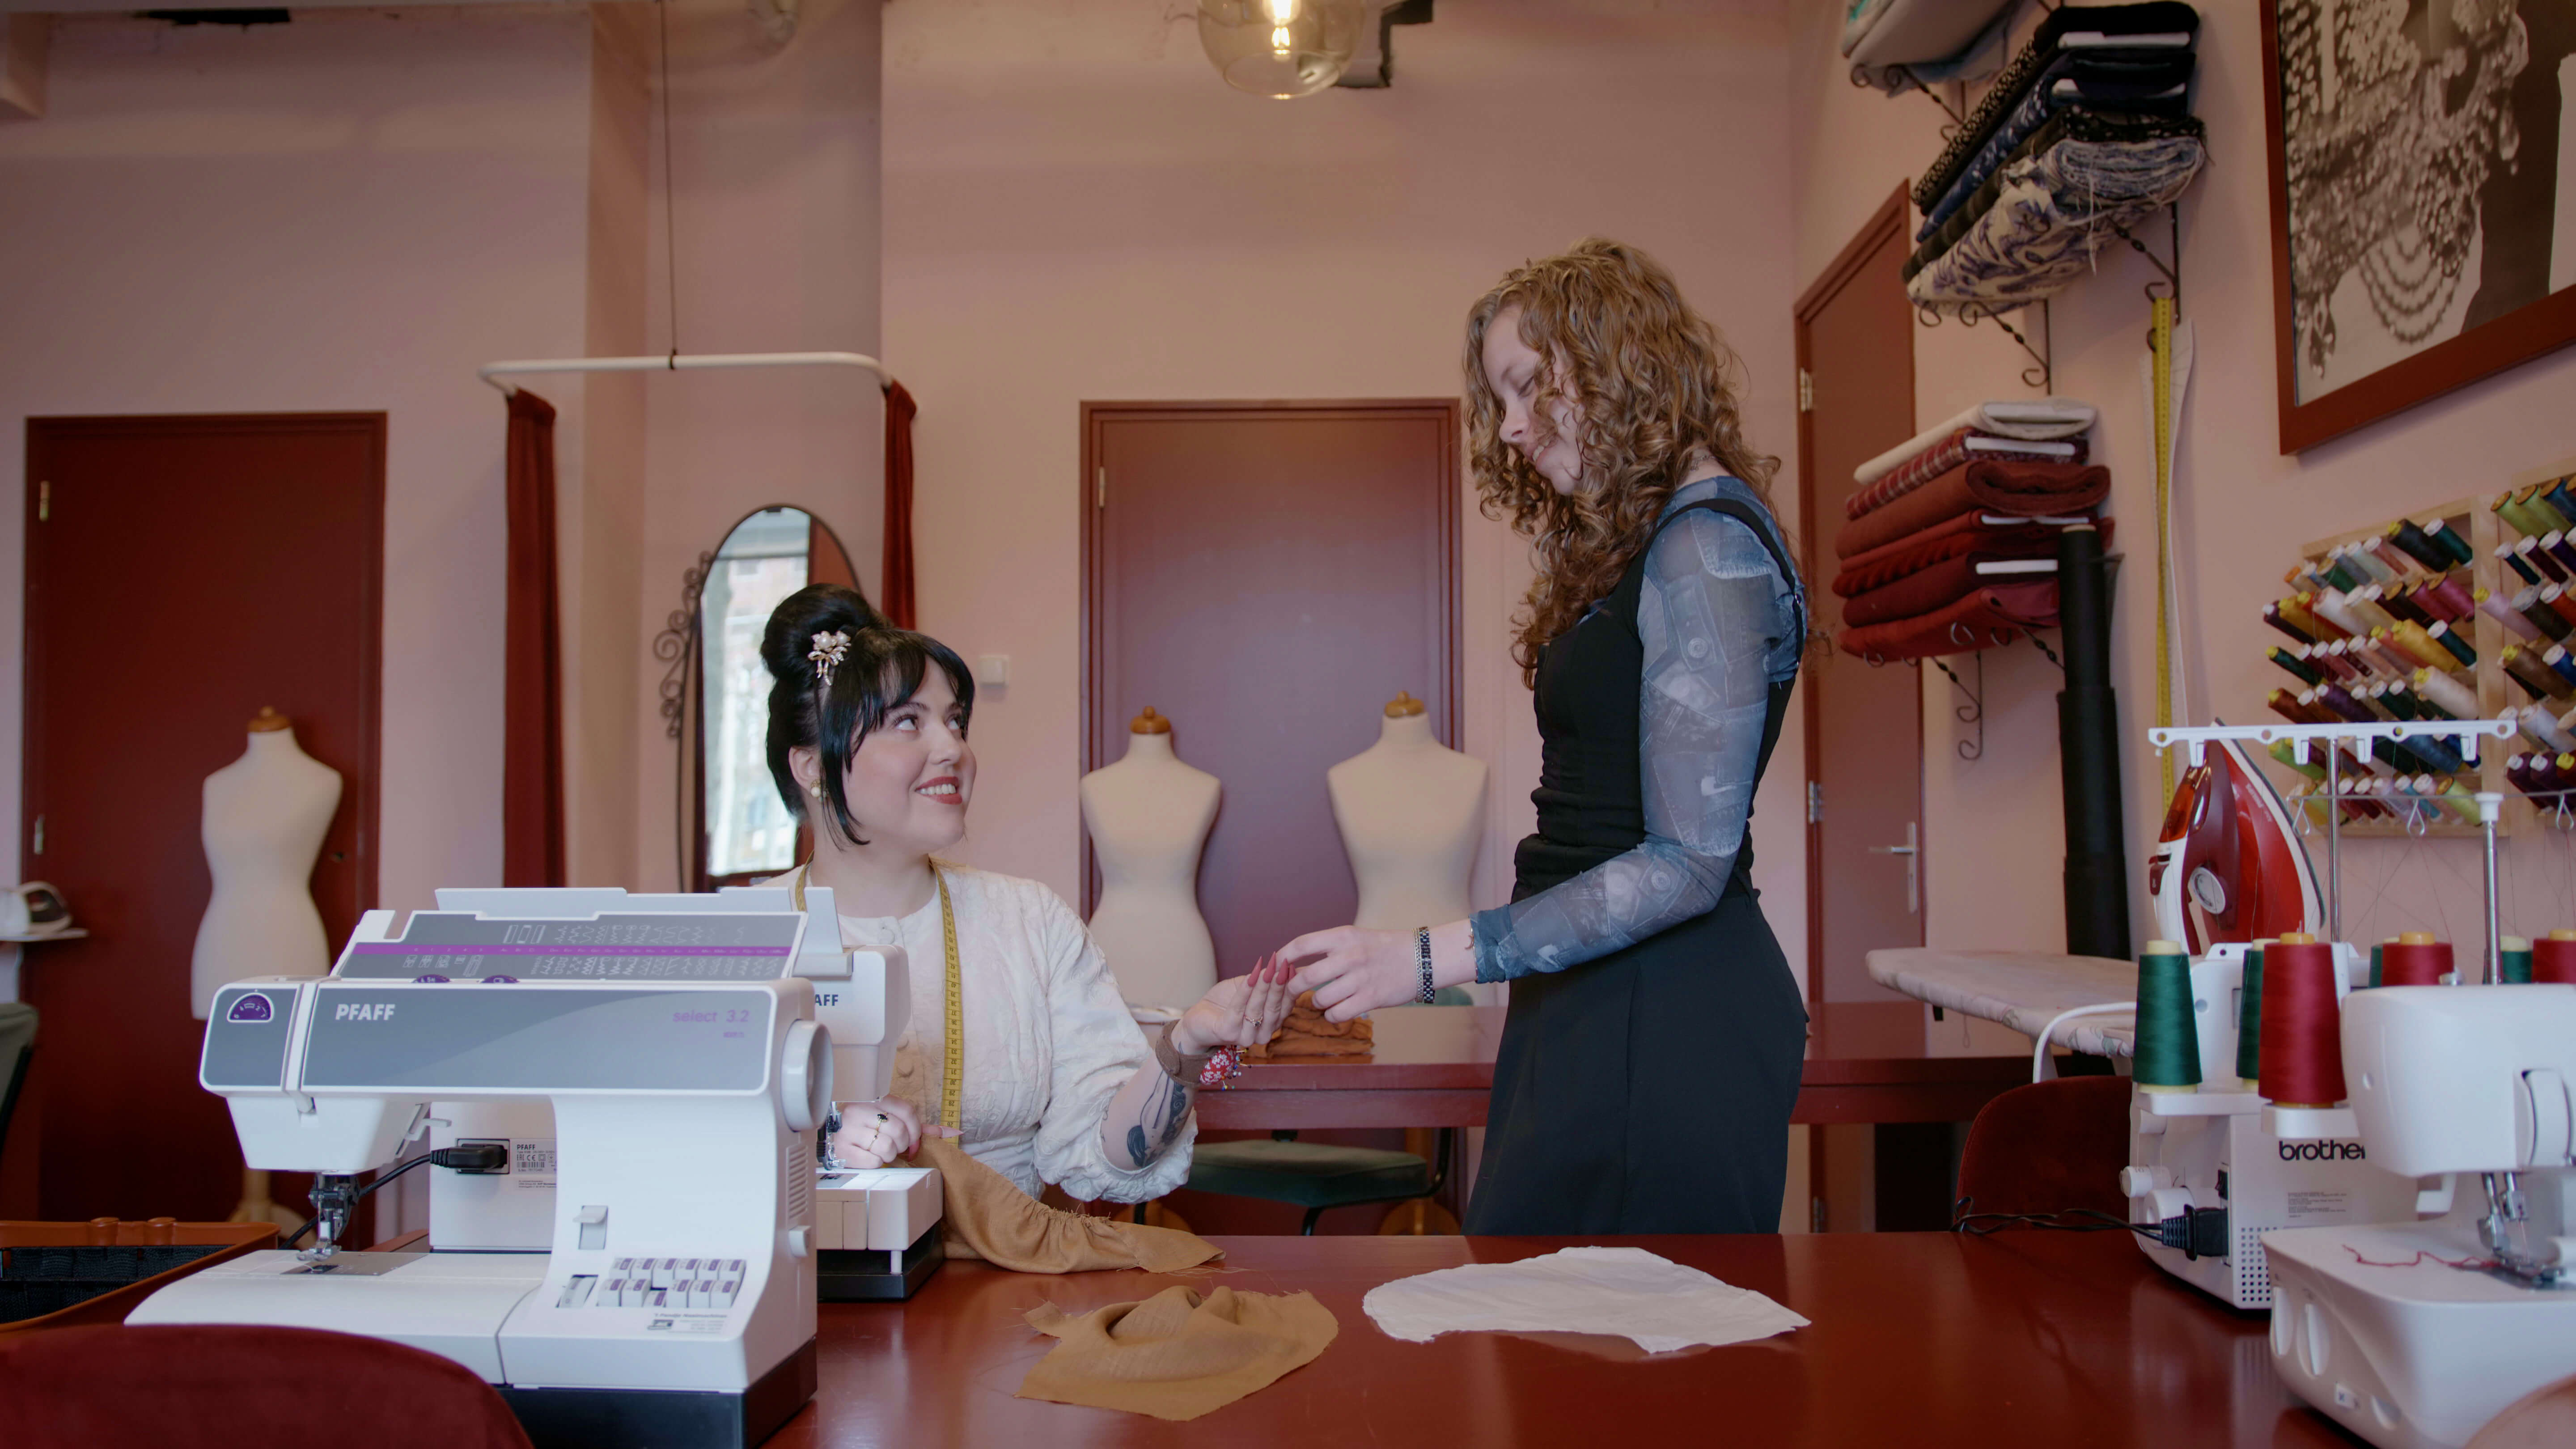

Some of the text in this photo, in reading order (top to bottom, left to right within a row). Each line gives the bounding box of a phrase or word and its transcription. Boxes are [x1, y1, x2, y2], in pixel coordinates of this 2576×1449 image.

[335, 1004, 396, 1020] PFAFF
[672, 1009, 750, 1022] select 3.2
